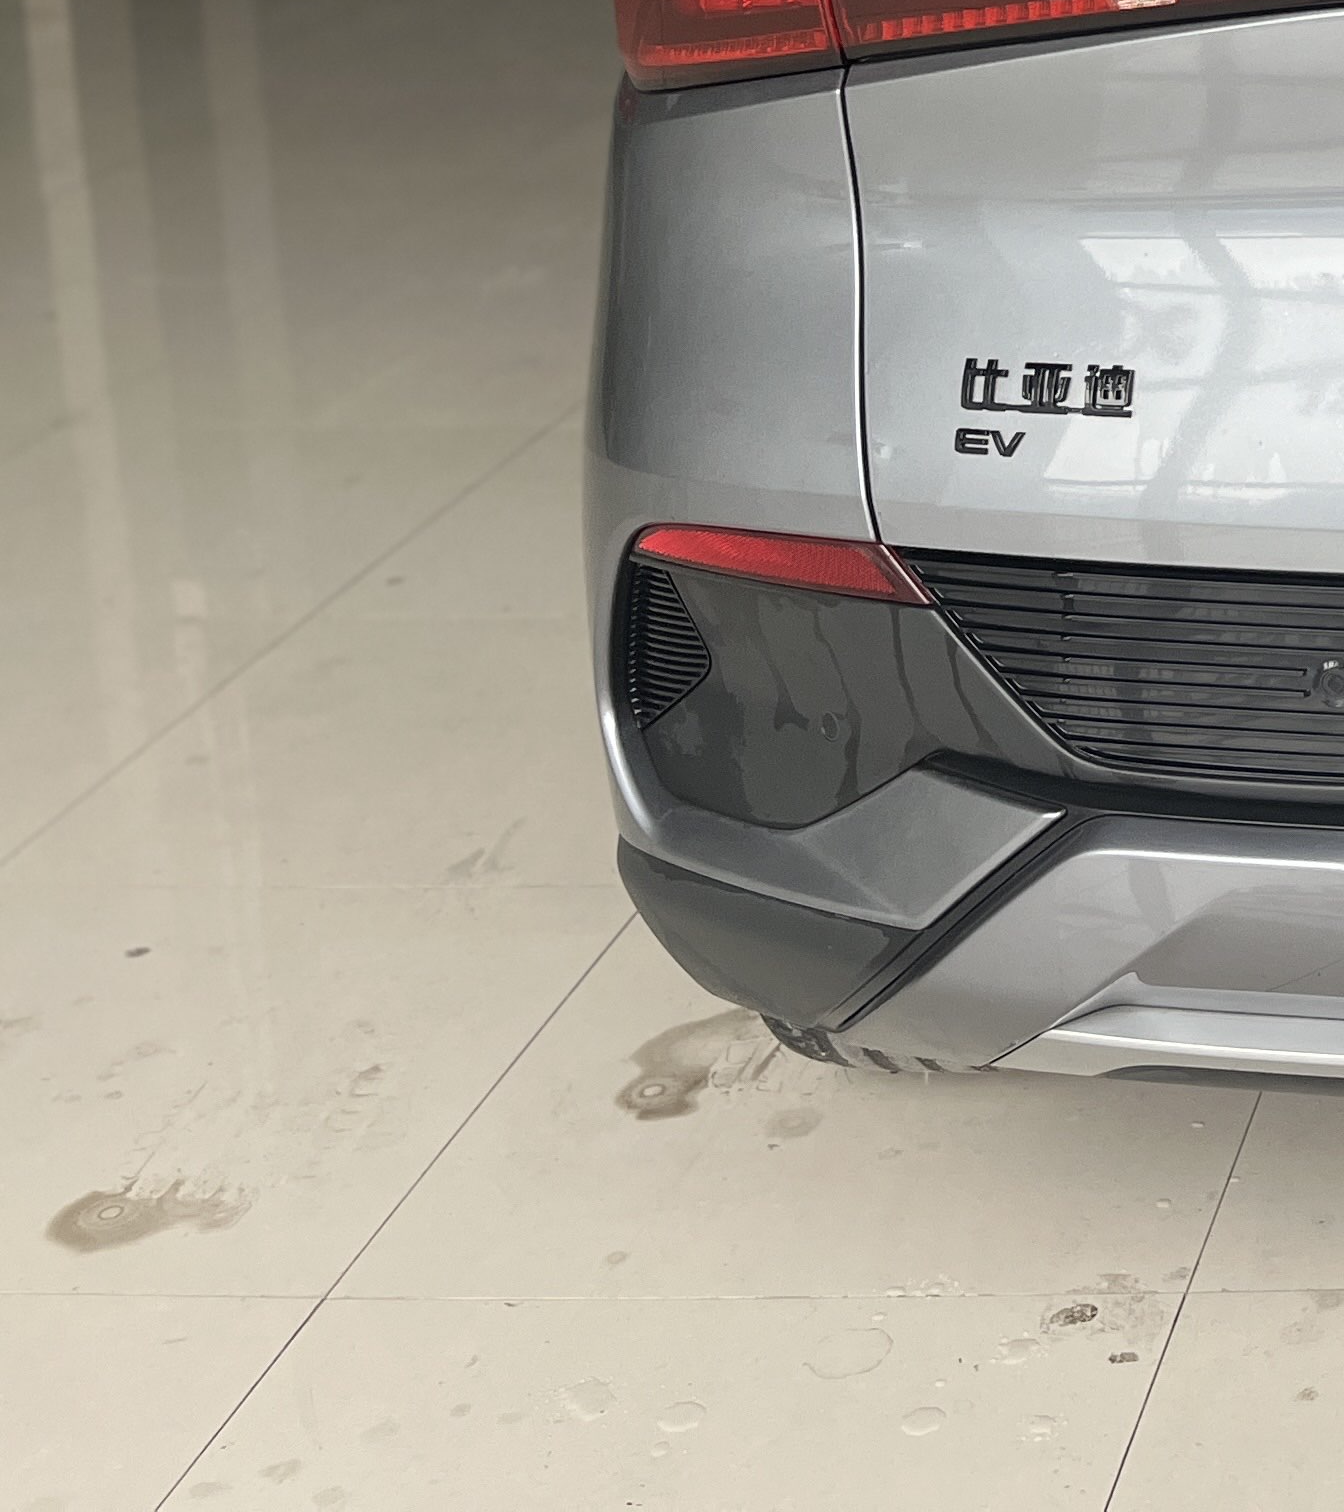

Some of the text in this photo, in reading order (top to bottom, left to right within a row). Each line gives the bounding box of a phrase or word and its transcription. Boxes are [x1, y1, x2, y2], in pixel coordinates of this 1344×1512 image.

[960, 357, 1136, 418] 比亚迪
[954, 427, 1027, 458] EV
